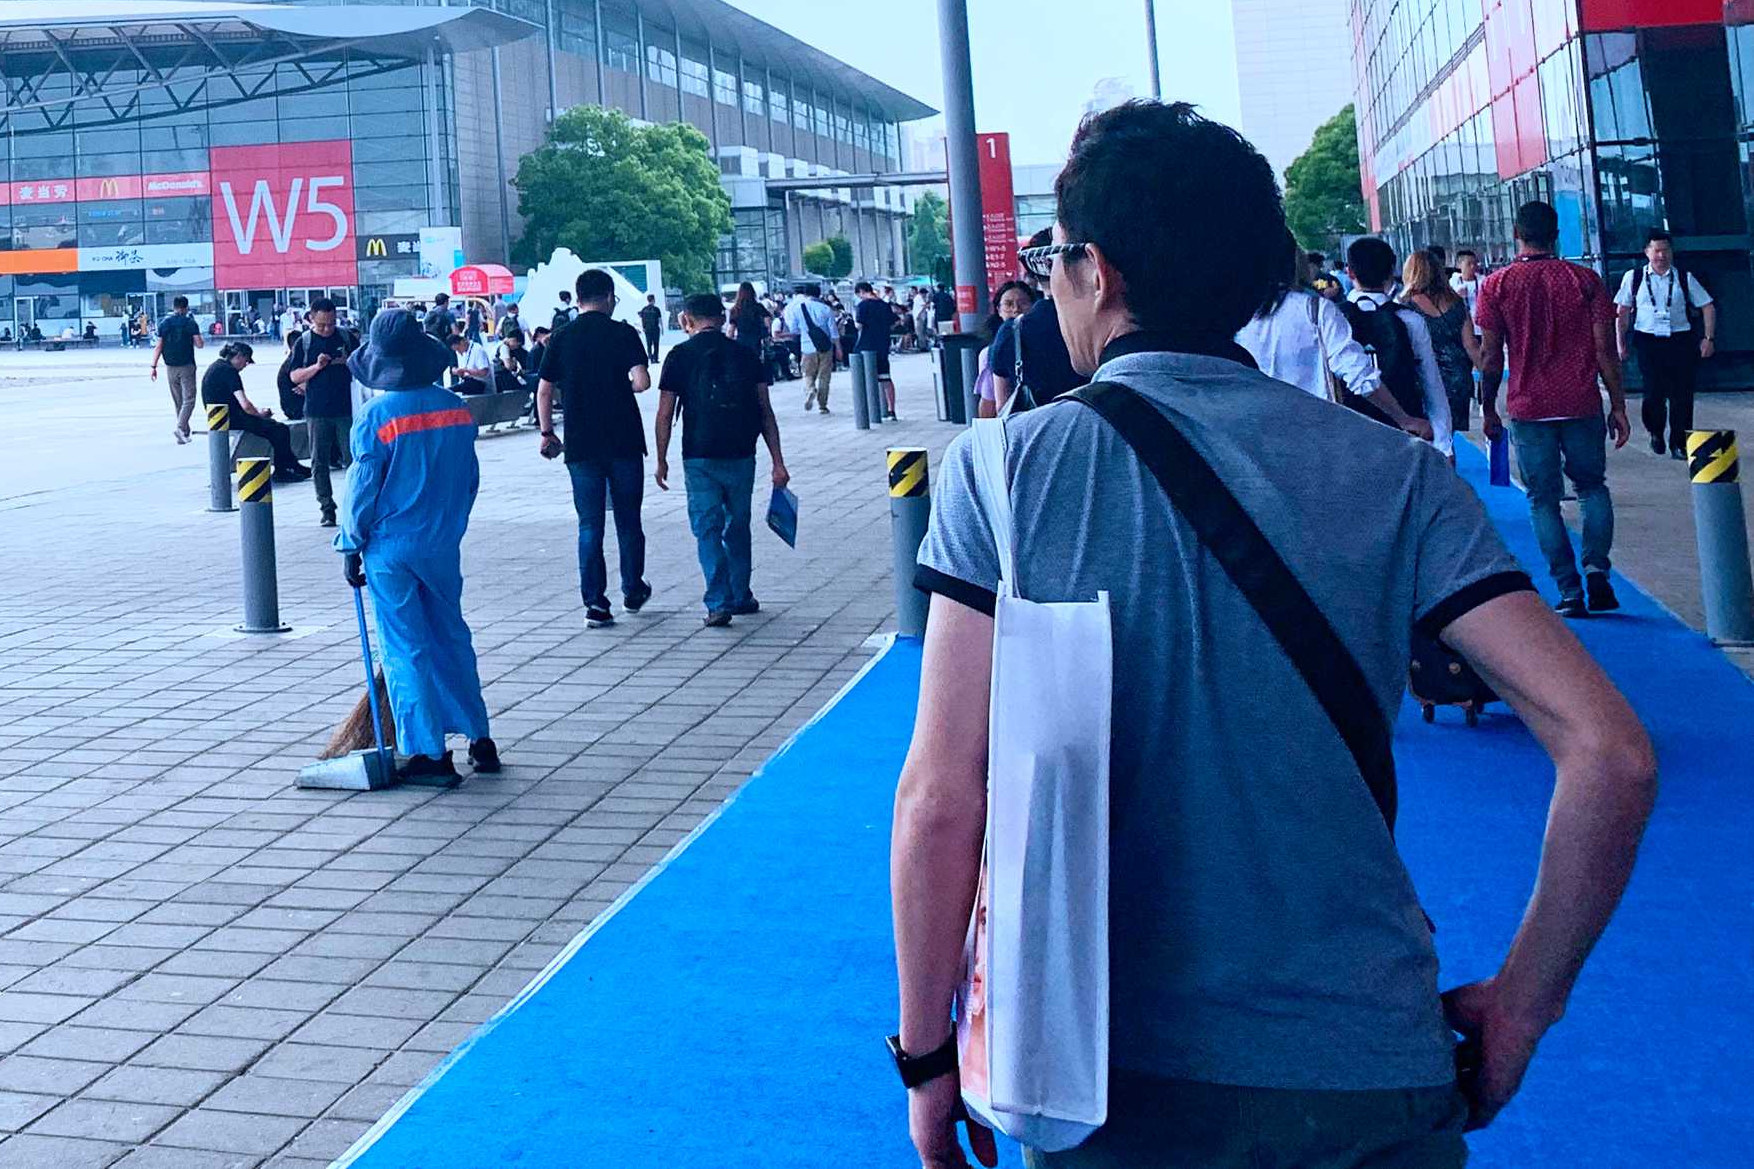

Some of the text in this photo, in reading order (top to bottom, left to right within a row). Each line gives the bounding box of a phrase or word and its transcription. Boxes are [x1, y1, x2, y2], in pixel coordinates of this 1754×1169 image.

[986, 137, 996, 159] 1
[19, 185, 68, 200] 麦当劳
[220, 175, 347, 255] W5
